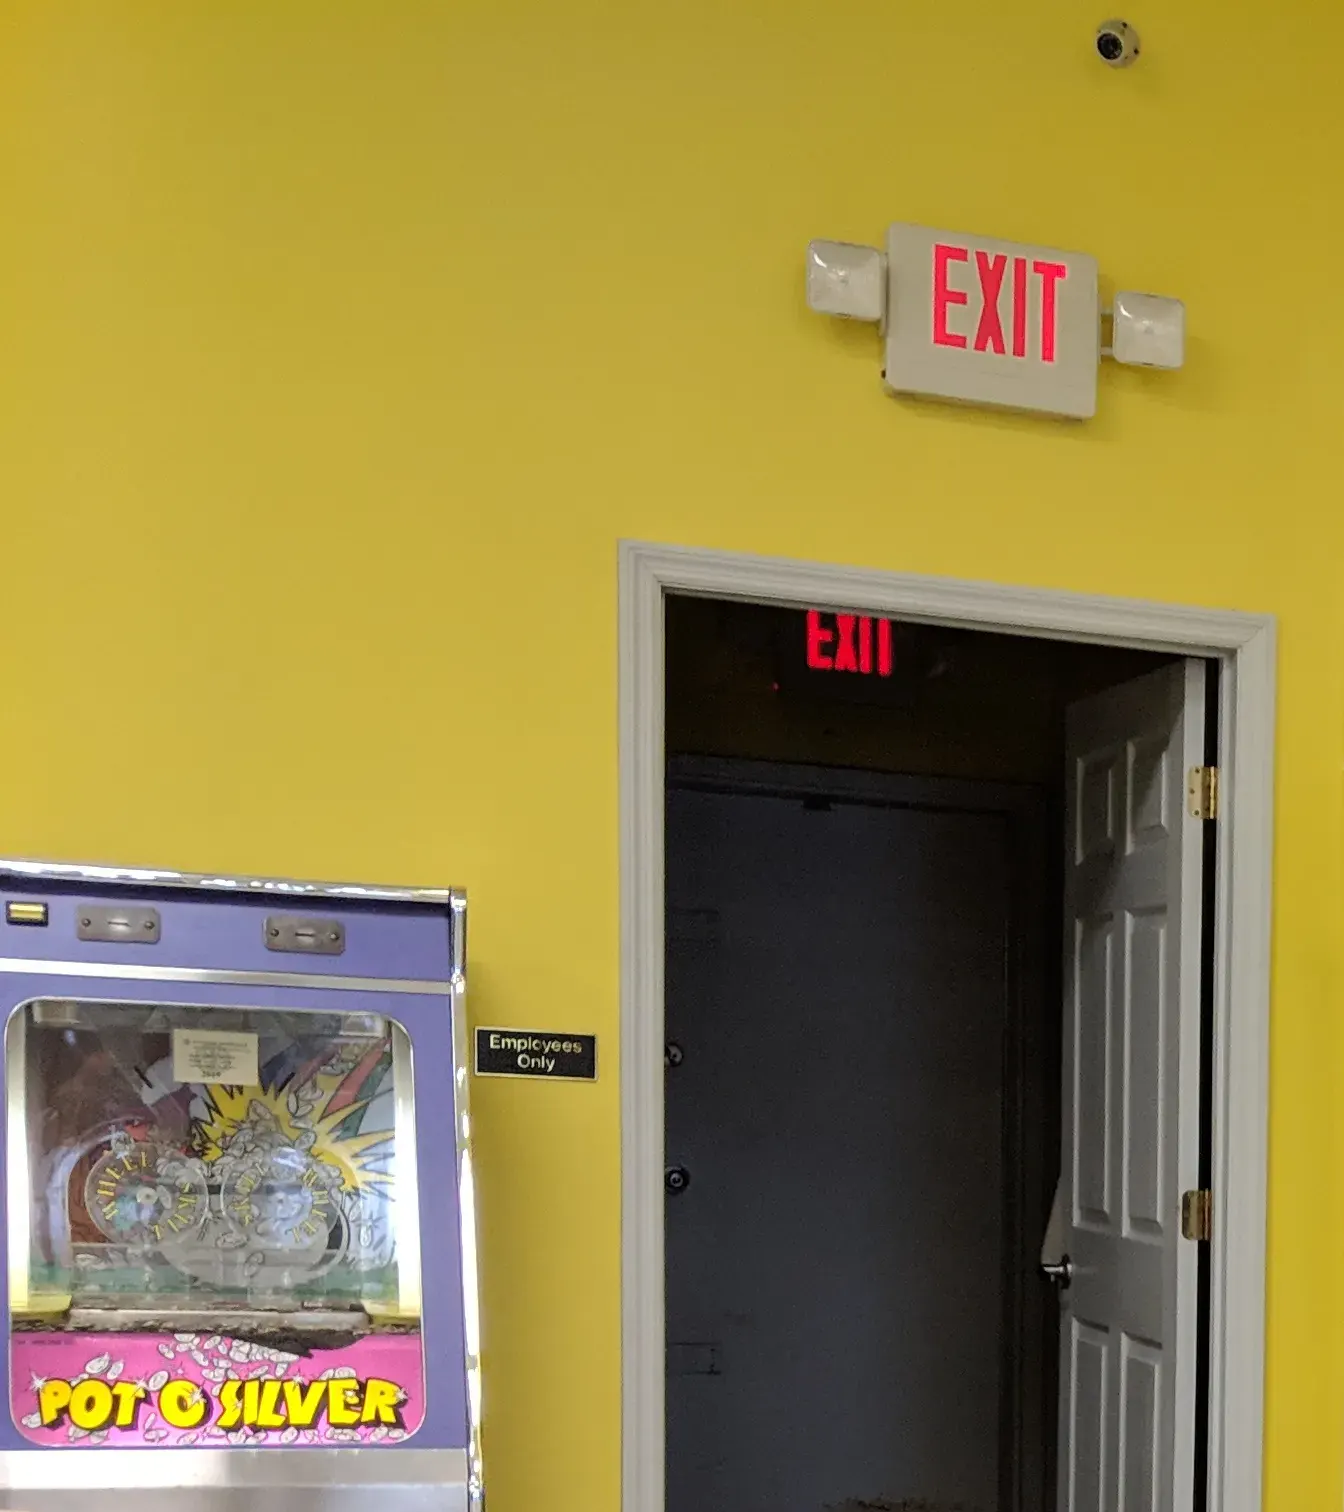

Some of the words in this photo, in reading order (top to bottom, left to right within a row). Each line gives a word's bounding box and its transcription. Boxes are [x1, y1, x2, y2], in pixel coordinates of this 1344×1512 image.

[932, 243, 1067, 363] EXIT
[806, 609, 893, 677] EXIT
[489, 1033, 583, 1055] Employees
[517, 1053, 556, 1073] Only
[40, 1378, 147, 1430] POT
[215, 1378, 402, 1431] SILVER
